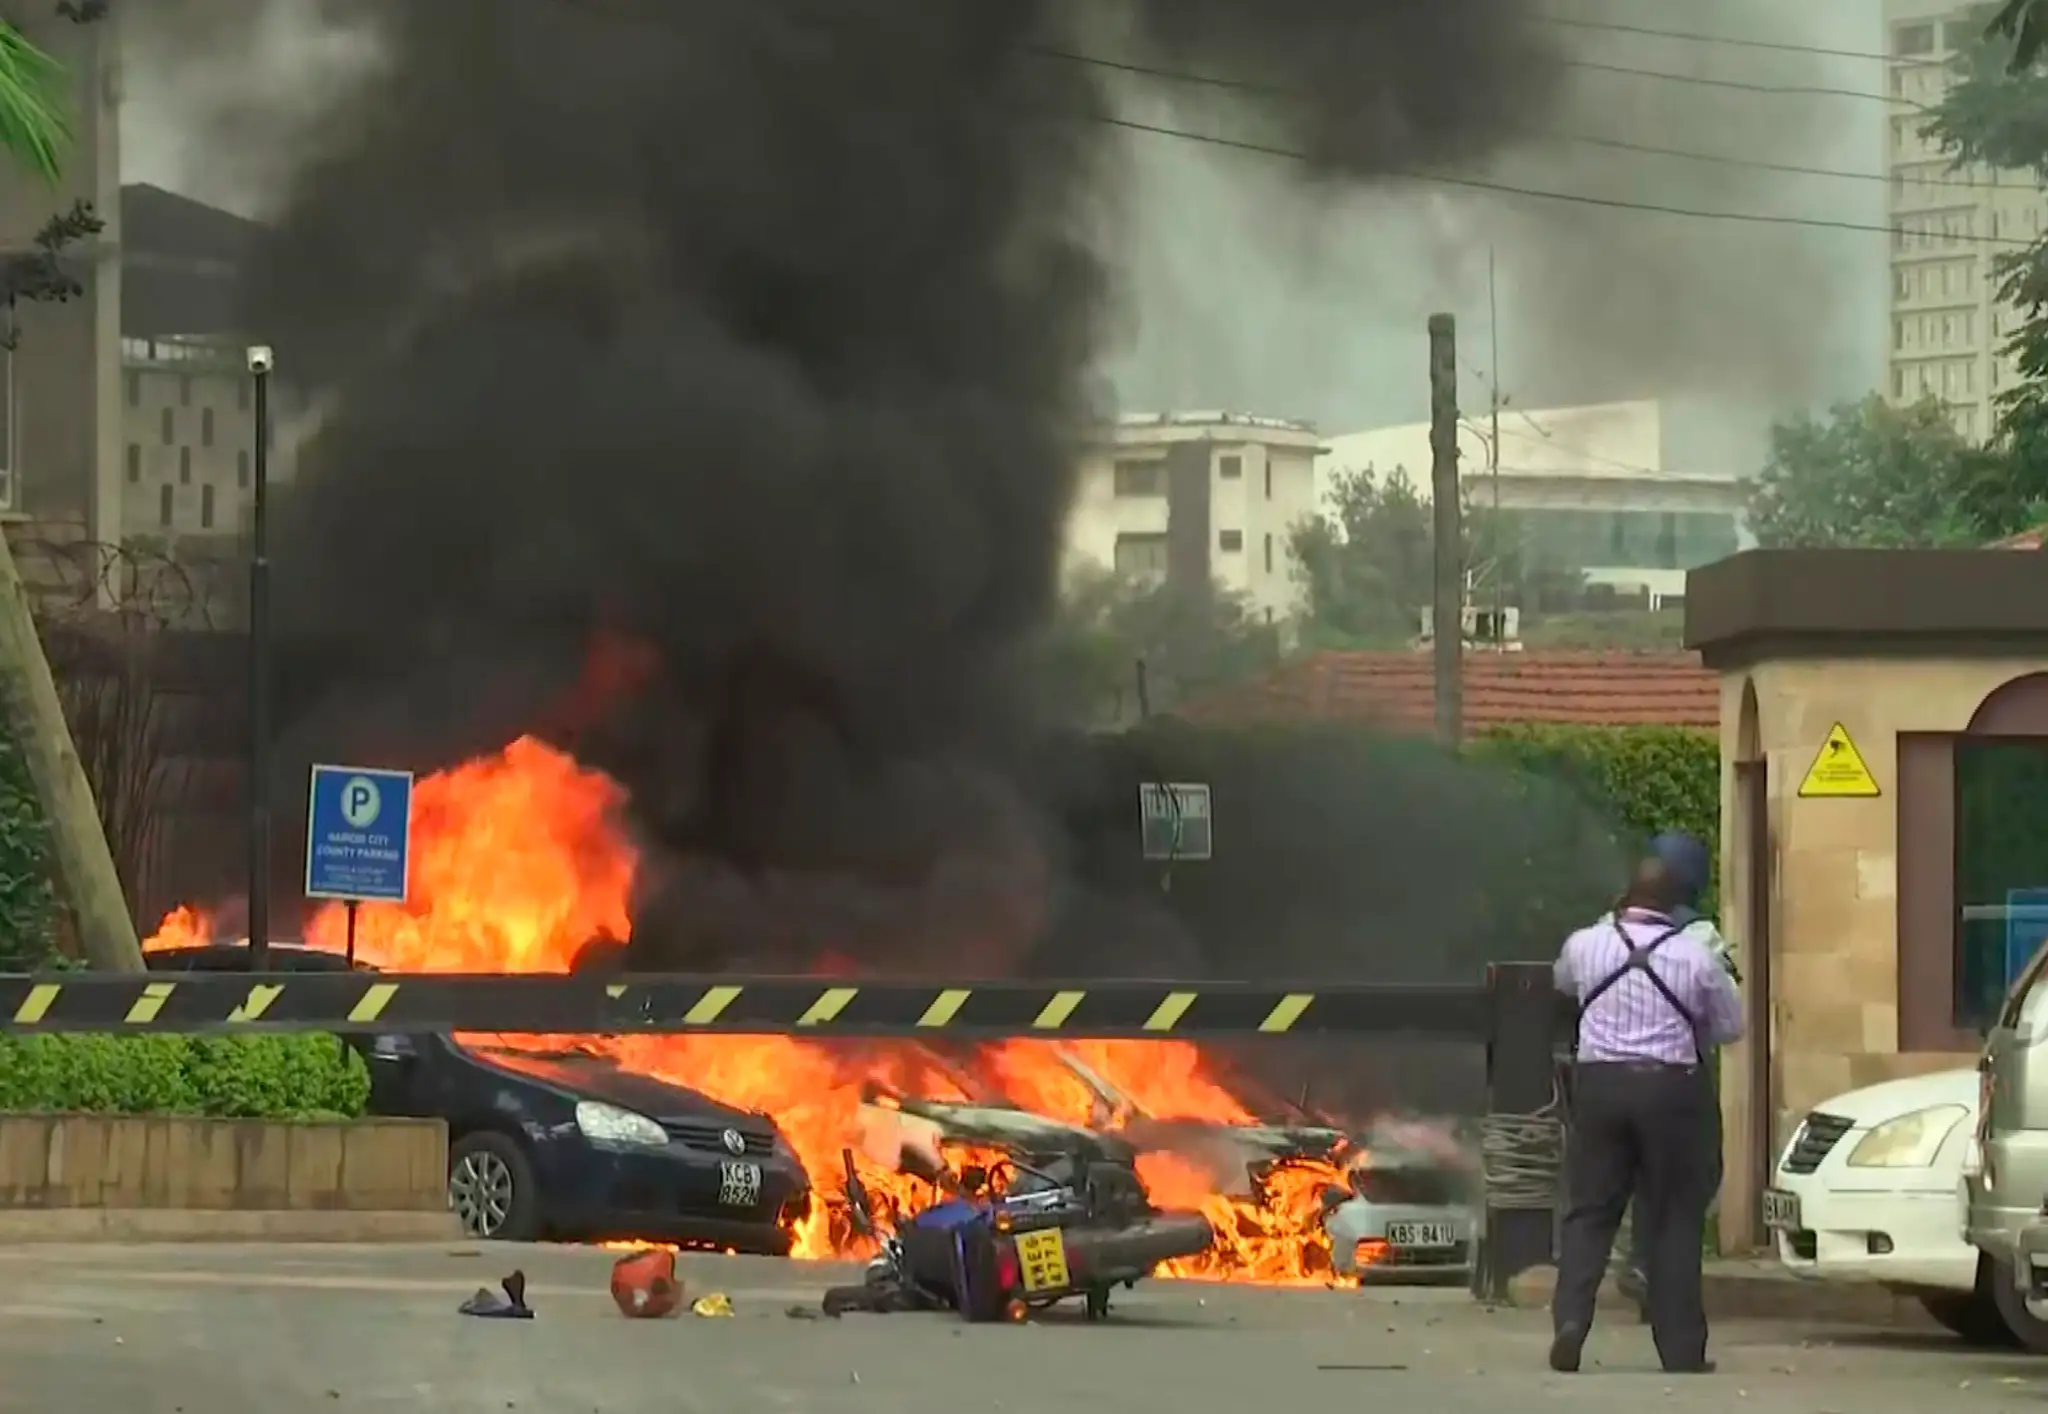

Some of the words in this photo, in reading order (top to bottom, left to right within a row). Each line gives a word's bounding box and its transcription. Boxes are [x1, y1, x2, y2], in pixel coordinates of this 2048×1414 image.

[351, 786, 370, 817] P
[368, 834, 389, 846] CITY
[317, 844, 355, 858] COUNTY
[357, 848, 399, 861] PARKING
[725, 1163, 752, 1184] KCB
[1390, 1225, 1416, 1244] KBS
